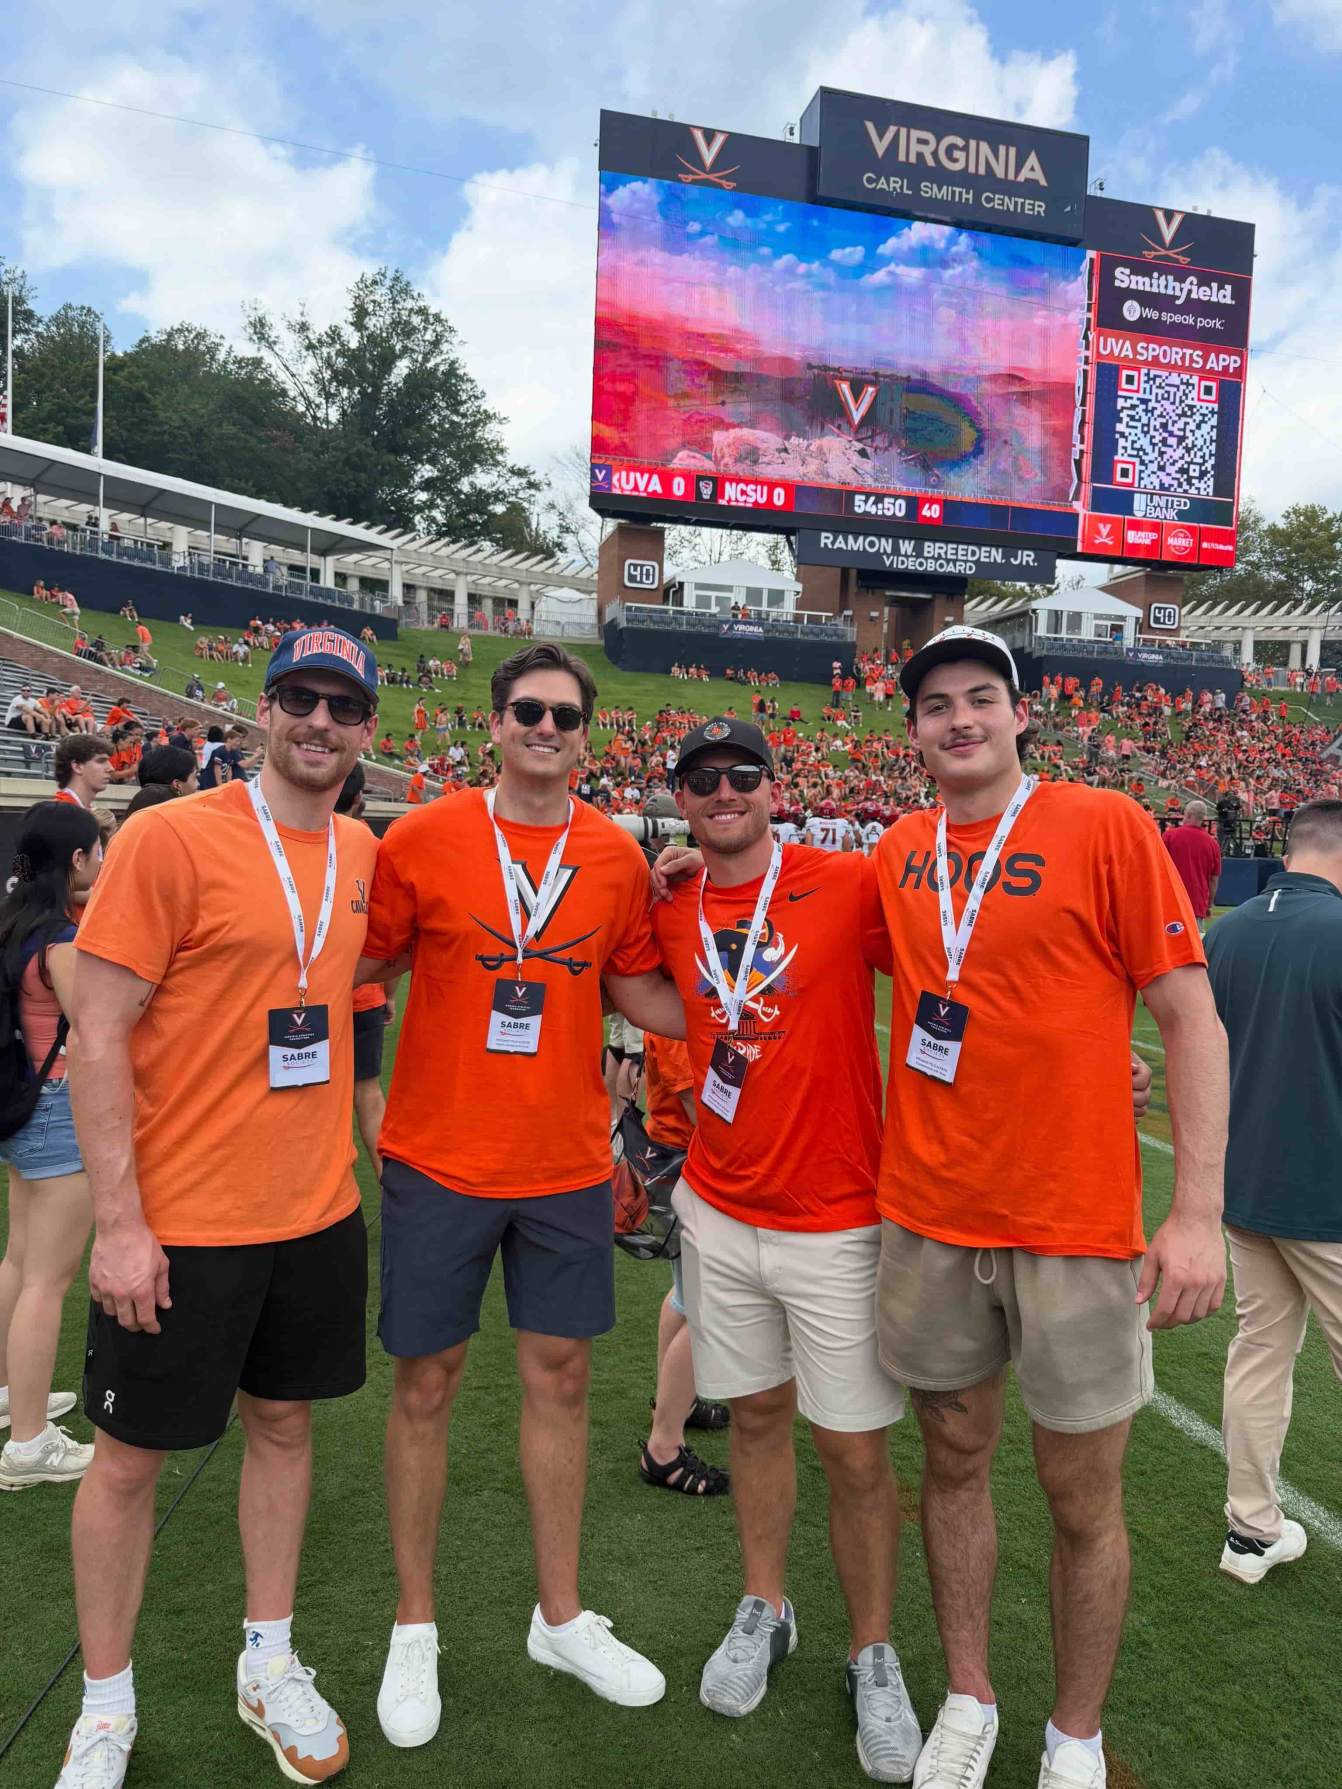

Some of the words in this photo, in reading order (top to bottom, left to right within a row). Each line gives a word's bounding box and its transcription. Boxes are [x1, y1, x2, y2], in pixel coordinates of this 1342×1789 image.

[864, 120, 1048, 187] VIRGINIA
[862, 172, 913, 195] CARL
[920, 181, 973, 204] SMITH
[981, 192, 1046, 216] CENTER
[1114, 266, 1235, 305] Smithfield
[1142, 307, 1159, 320] We
[1161, 311, 1195, 325] speak
[1100, 335, 1134, 358] UVA
[1136, 342, 1204, 368] SPORTS
[1206, 352, 1241, 373] APP
[621, 470, 663, 494] UVA
[672, 477, 685, 496] 0
[724, 481, 768, 504] NCSU
[773, 487, 785, 506] 0
[1147, 494, 1190, 510] UNITED
[854, 494, 906, 517] 54:50
[921, 504, 940, 518] 40
[1147, 506, 1179, 520] BANK
[820, 532, 892, 556] RAMON
[899, 540, 916, 556] W.
[1010, 550, 1038, 567] JR.
[1168, 536, 1193, 547] MARKET
[629, 564, 654, 584] 40
[883, 555, 976, 574] VIDEOBOARD
[1155, 608, 1174, 625] 40
[733, 624, 763, 633] VIRGINIA
[292, 631, 366, 679] VIRGINIA
[820, 828, 836, 845] 71
[899, 850, 1045, 897] HOOS
[967, 909, 977, 927] SABRE
[500, 1020, 531, 1030] SABRE
[282, 1051, 318, 1062] SABRE
[921, 1038, 950, 1056] SABRE
[712, 1079, 733, 1099] SABRE
